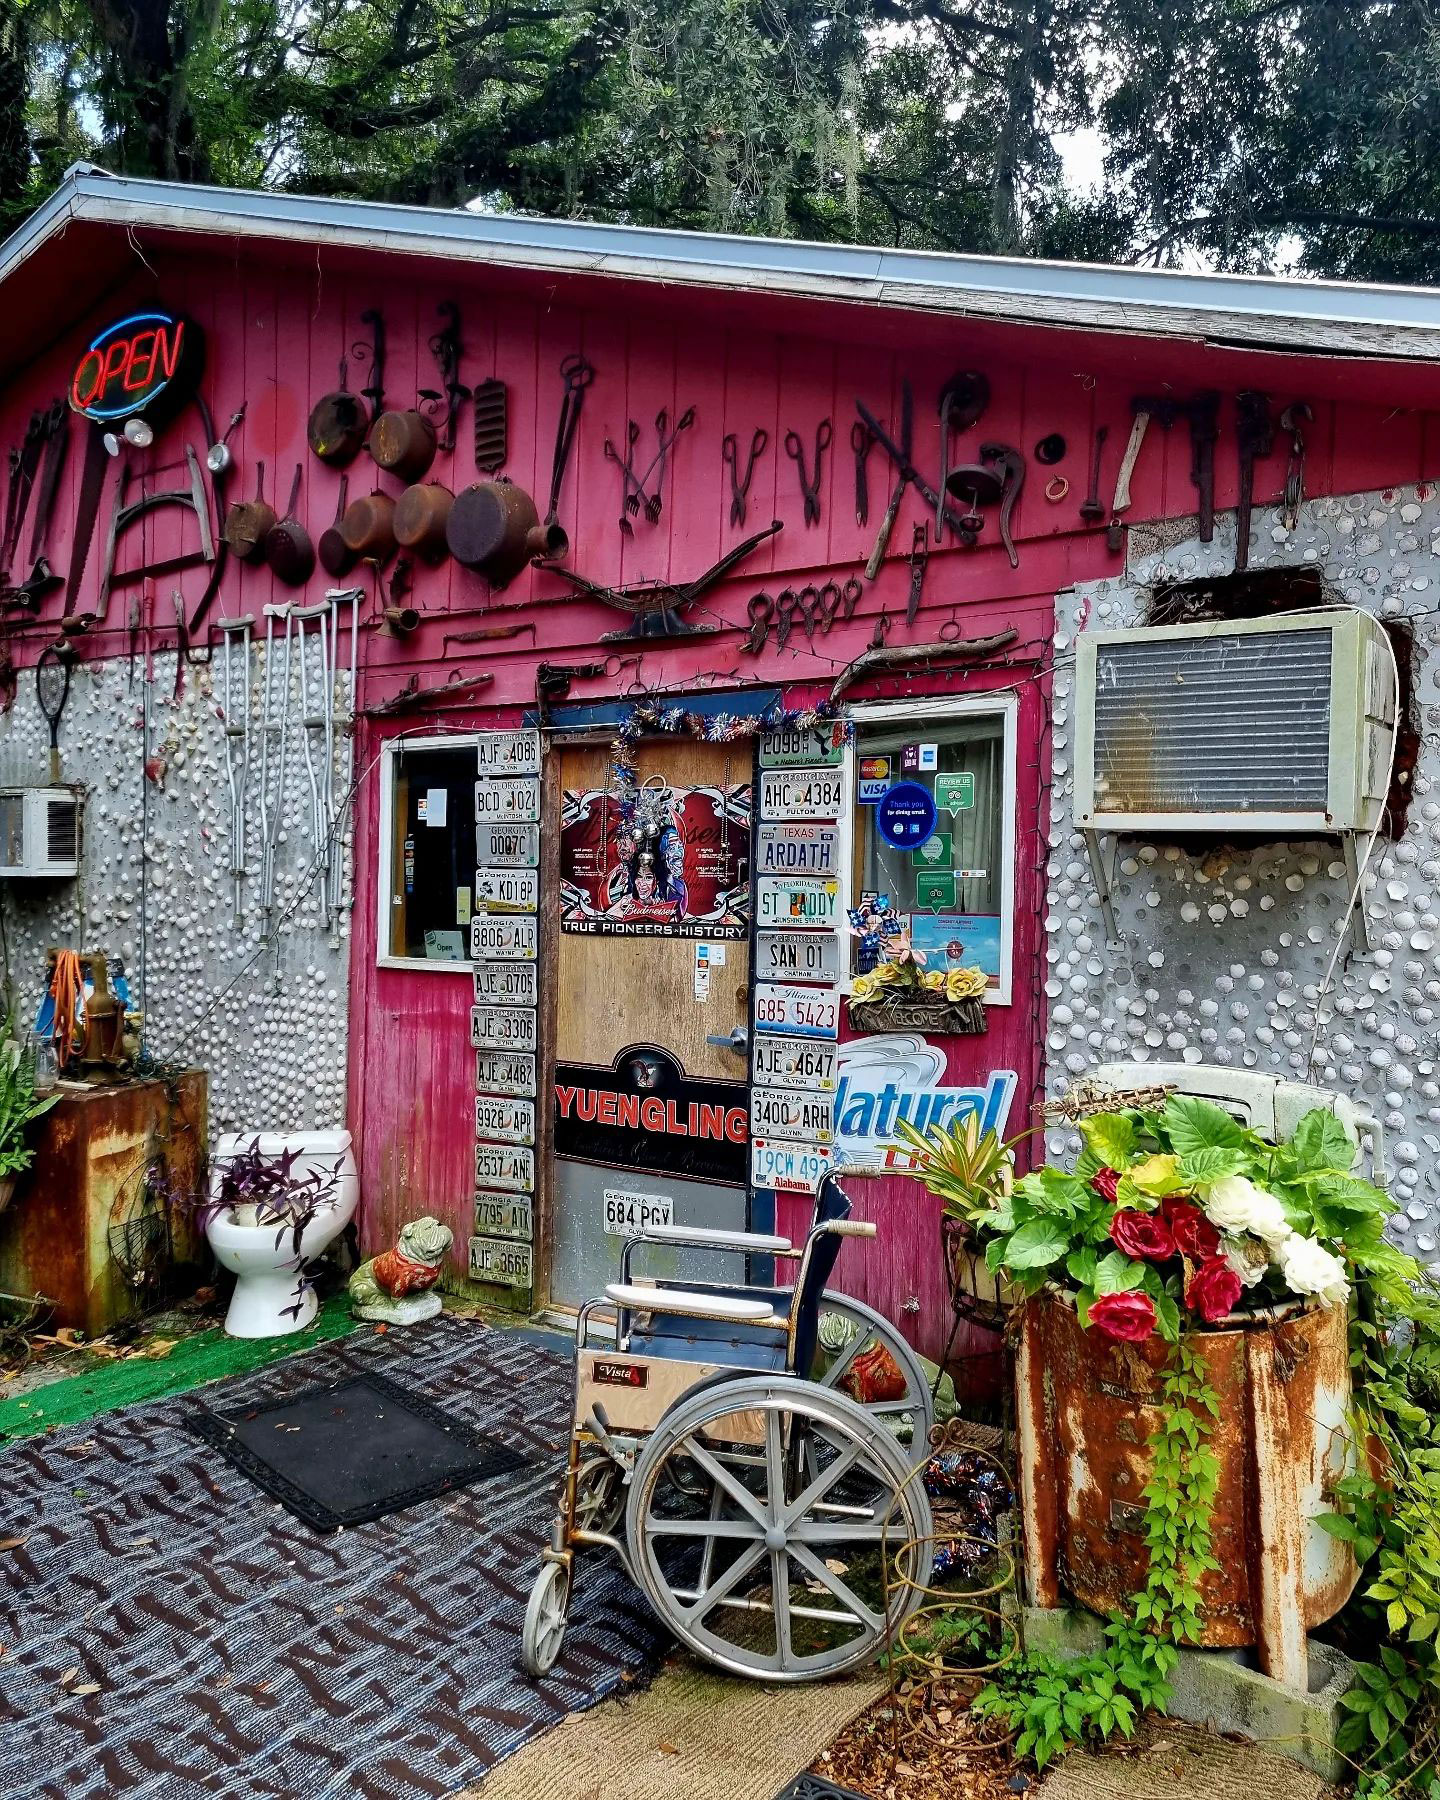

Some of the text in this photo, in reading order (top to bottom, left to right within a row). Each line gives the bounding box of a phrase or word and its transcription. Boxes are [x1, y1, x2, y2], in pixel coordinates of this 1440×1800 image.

[73, 320, 184, 408] OPEN
[480, 741, 536, 764] AJF 4086
[763, 732, 801, 754] 2098
[780, 772, 827, 781] GEORGIA
[765, 782, 841, 807] AHC 4384
[863, 783, 888, 794] VISA
[478, 792, 500, 811] BCD
[491, 826, 527, 834] GEORGIA
[783, 827, 815, 838] TEXAS
[765, 843, 831, 868] ARDATH
[499, 880, 533, 901] KD18P
[621, 900, 678, 917] Budweiser
[762, 892, 779, 915] ST
[474, 928, 534, 949] 8806 ALR
[562, 921, 746, 938] TRUE PIONEERS HISTORY
[775, 934, 821, 943] GEORGIA
[436, 943, 453, 952] Open
[770, 943, 797, 968] SAN
[476, 974, 533, 993] AJE 0705
[782, 988, 820, 1001] Illinois
[757, 998, 835, 1028] G85 5423
[884, 1010, 939, 1026] WELCOME
[473, 1017, 532, 1039] AJE 3306
[772, 1042, 820, 1052] GEORGIA
[478, 1061, 532, 1085] AJE 4482
[756, 1049, 834, 1078] AJE 4647
[782, 1077, 807, 1085] GLYNN
[476, 1100, 514, 1109] GEORGIA
[753, 1091, 803, 1101] GEORGIA
[477, 1107, 504, 1129] 9928
[555, 1084, 748, 1144] YUENGLING
[754, 1100, 830, 1130] 3400 ARH
[780, 1128, 803, 1136] GLYNN
[476, 1147, 514, 1156] GEORGIA
[477, 1156, 504, 1177] 2537
[757, 1150, 794, 1177] 19CW
[774, 1176, 811, 1191] Alabama
[606, 1193, 648, 1204] GEORGIA
[476, 1203, 503, 1225] 7795
[607, 1200, 634, 1227] 684
[471, 1248, 529, 1277] AJE 3665
[600, 1365, 632, 1378] Vista
